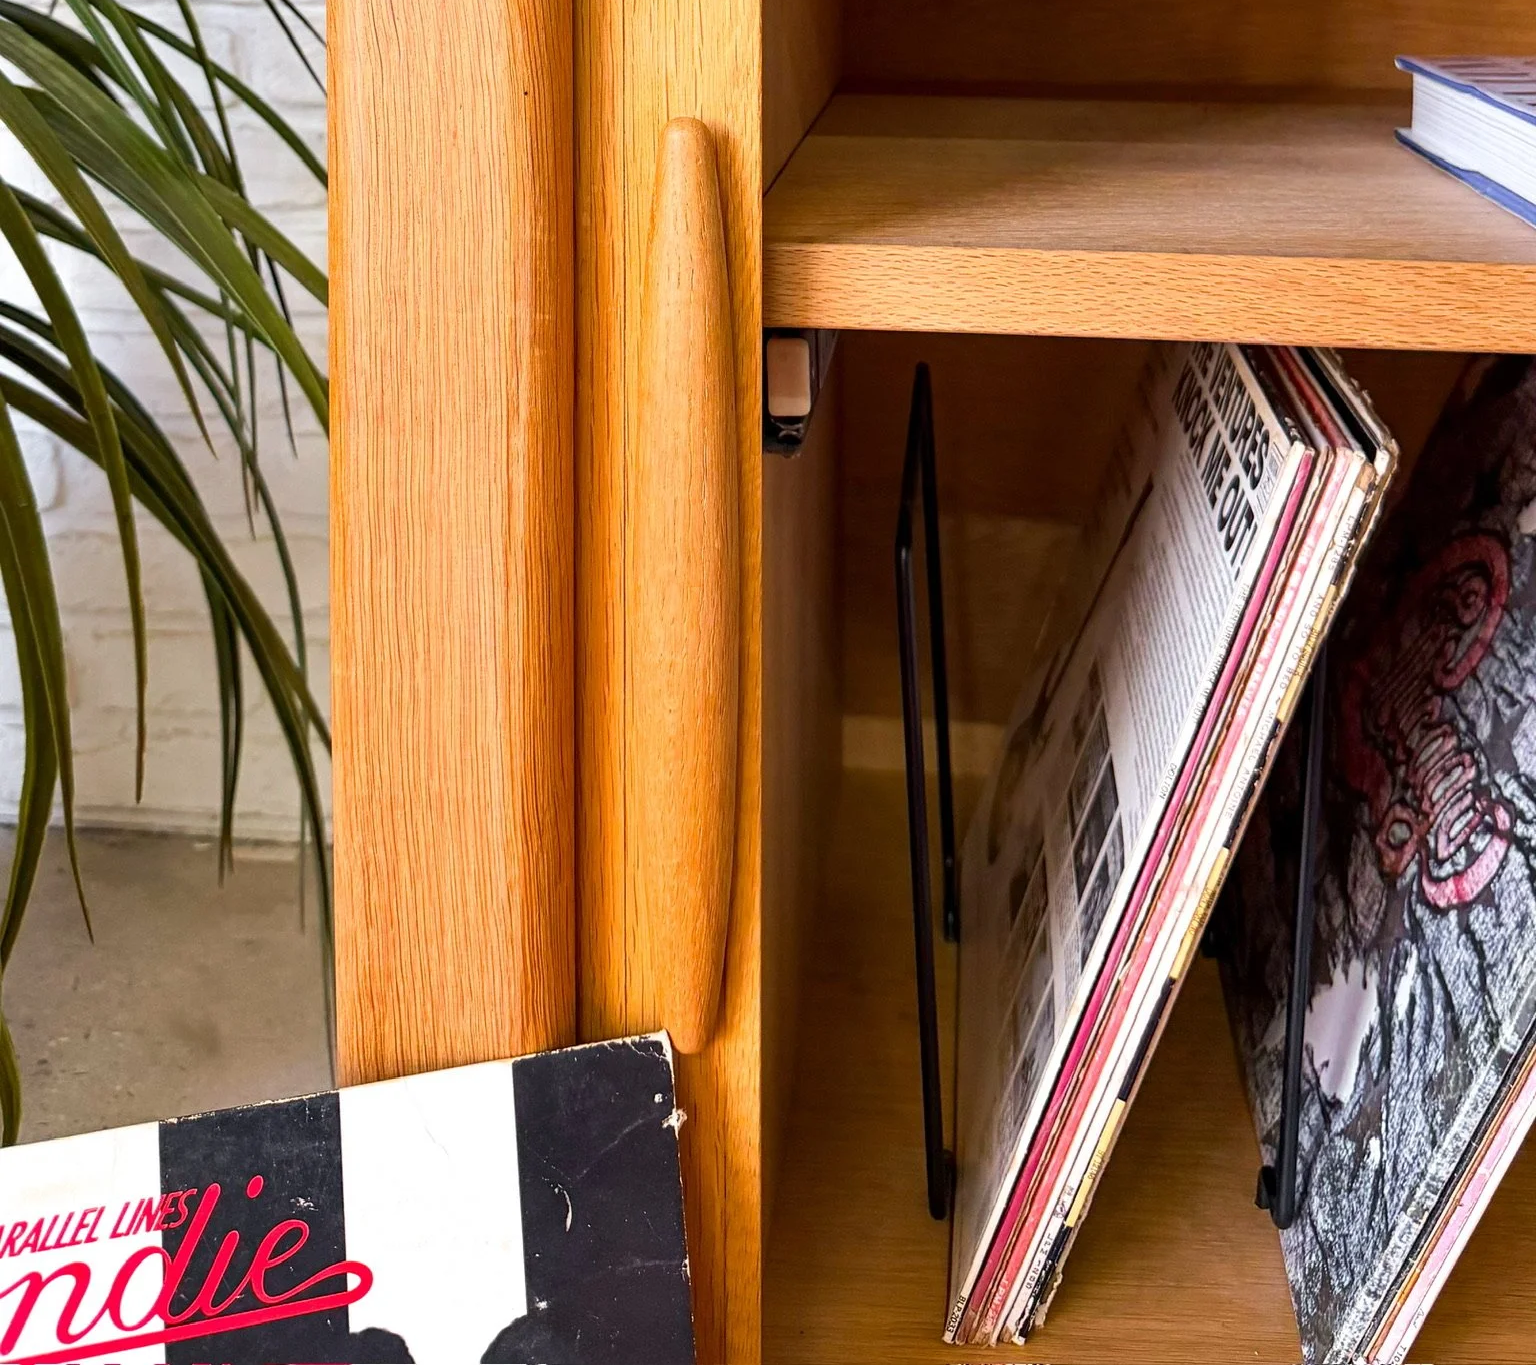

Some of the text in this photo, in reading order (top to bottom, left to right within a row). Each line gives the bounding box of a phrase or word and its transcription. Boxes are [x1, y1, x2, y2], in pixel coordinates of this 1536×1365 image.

[1209, 342, 1269, 491] VENTURES
[1200, 428, 1232, 510] ME
[1217, 474, 1258, 582] OUT!
[1218, 602, 1242, 651] VENTURES
[1237, 583, 1250, 603] THE
[1225, 594, 1324, 819] AND SO TO BED MICHAEL ANTOINE
[109, 1188, 198, 1240] LINES
